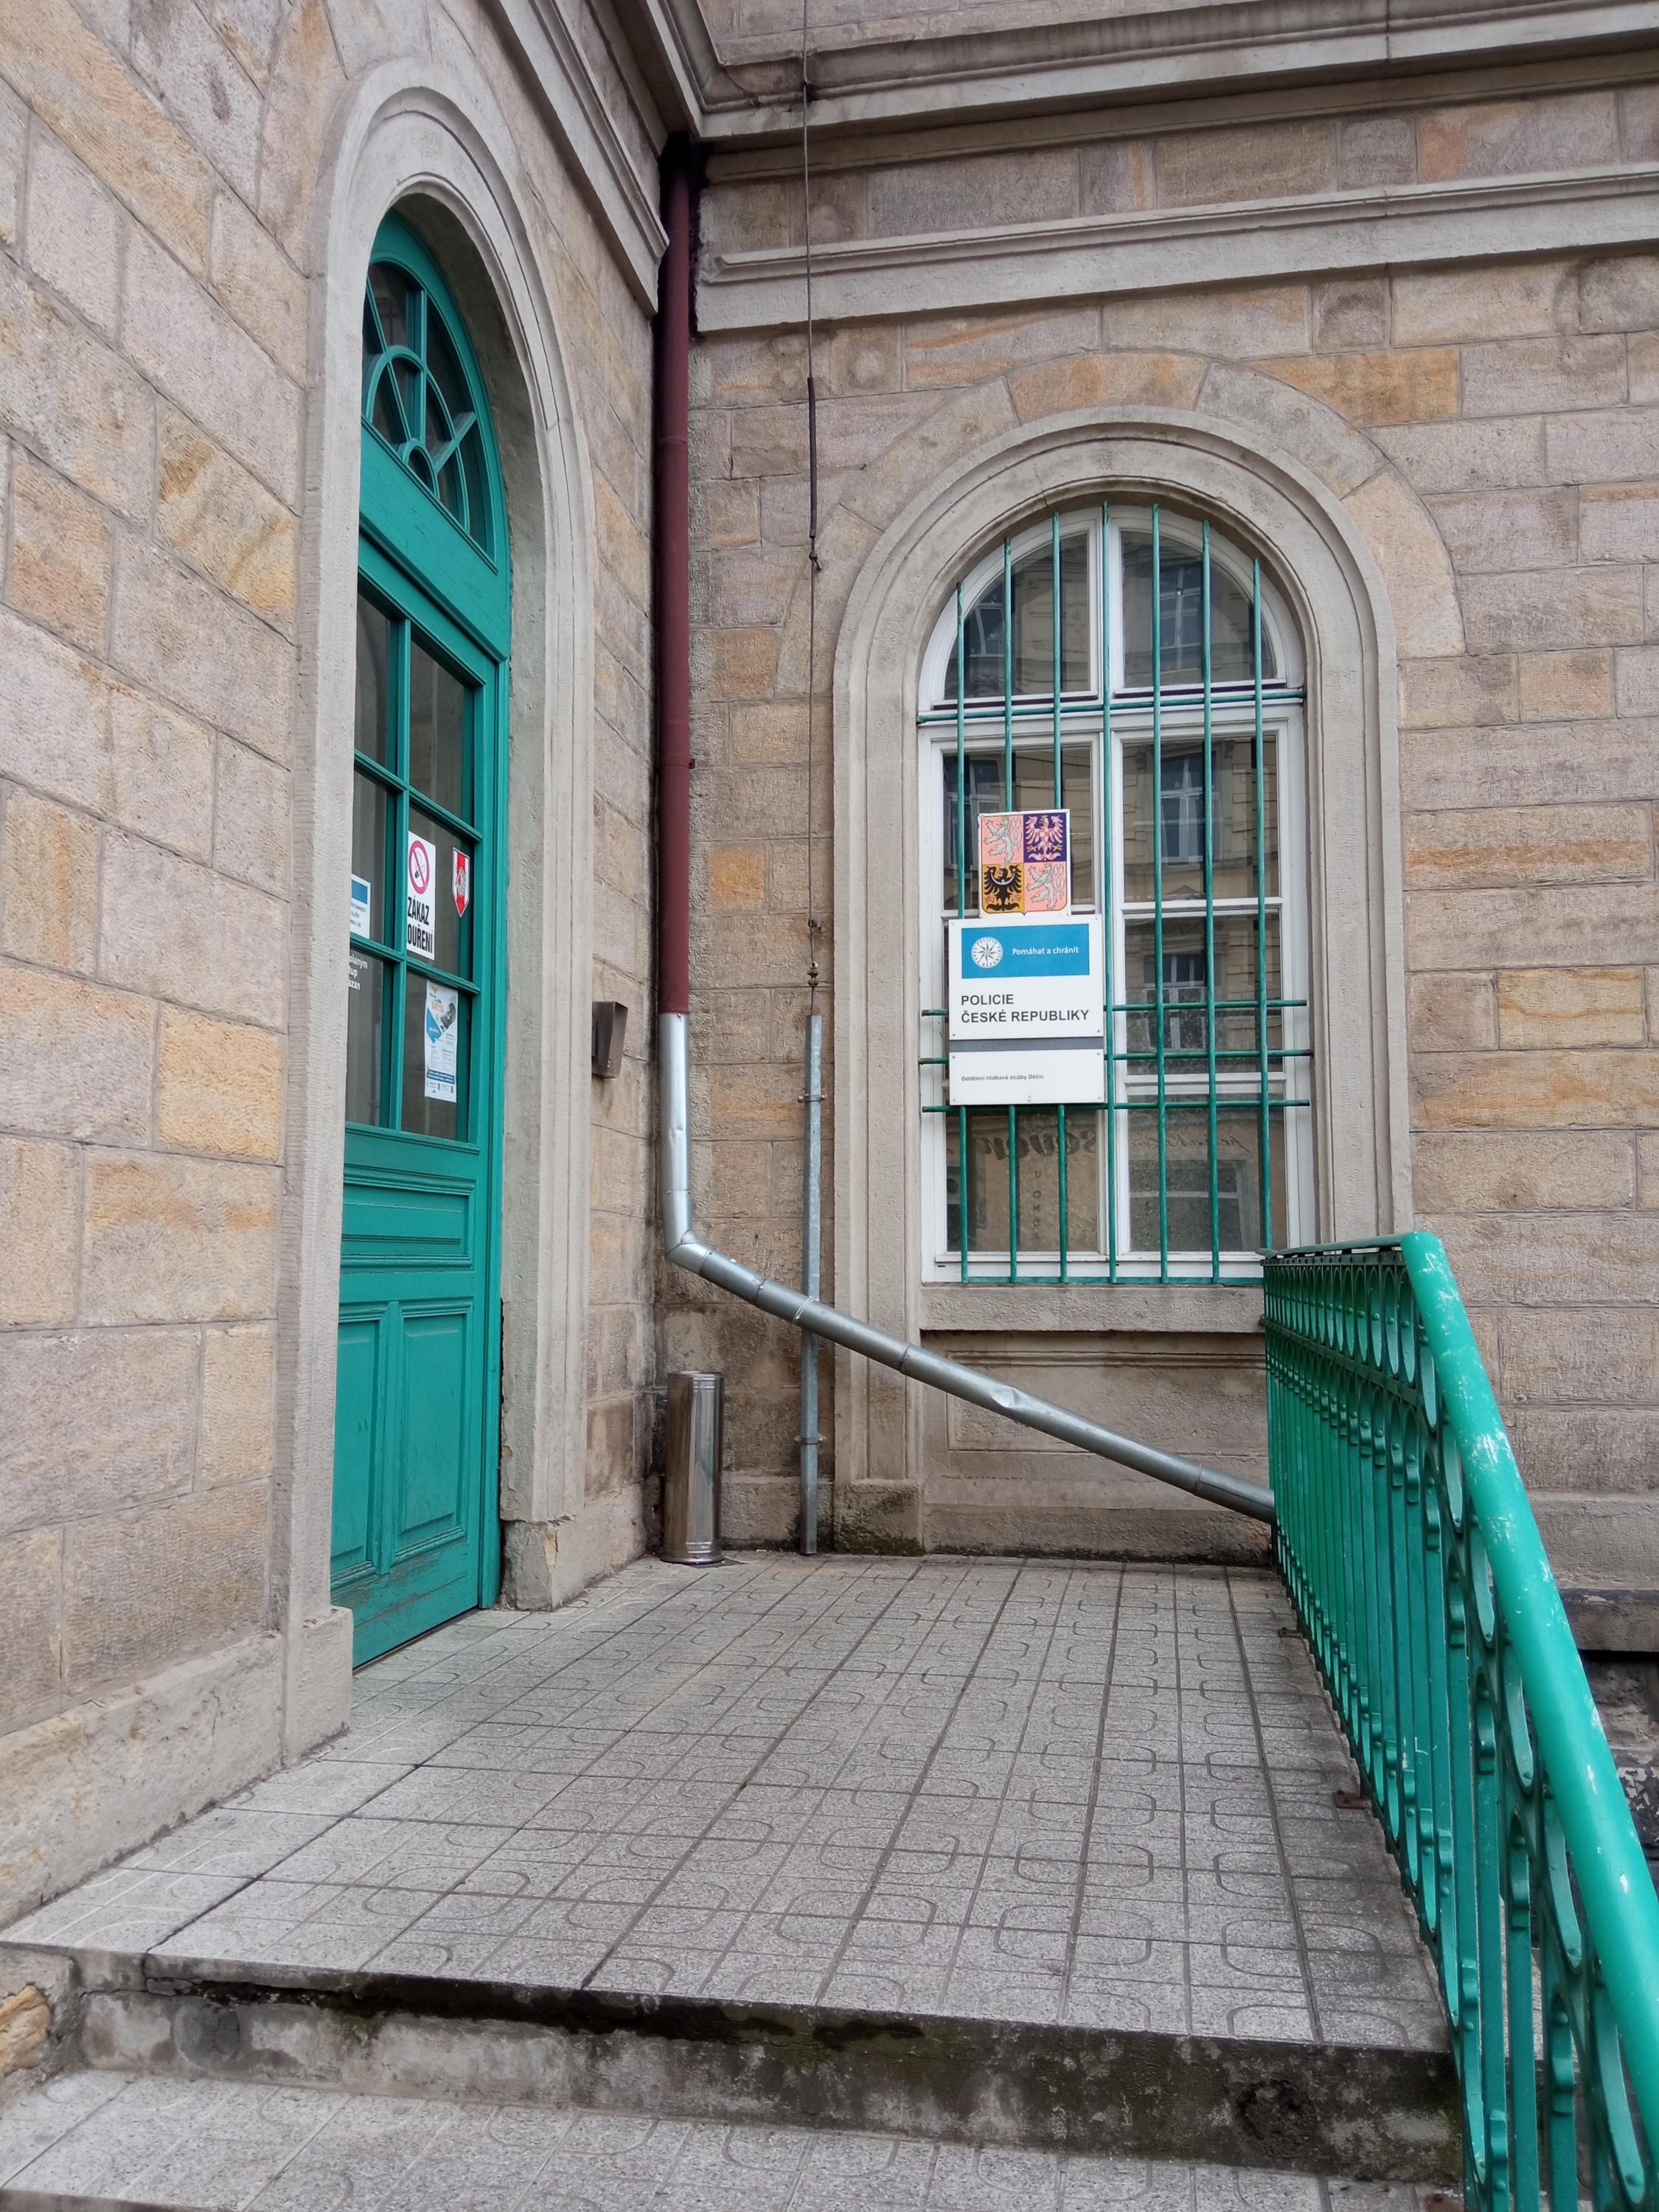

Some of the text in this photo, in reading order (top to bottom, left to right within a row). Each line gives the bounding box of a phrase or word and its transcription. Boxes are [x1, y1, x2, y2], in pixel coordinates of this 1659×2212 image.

[408, 896, 430, 925] ZÁKAZ
[407, 923, 434, 954] OUŘENÍ
[1012, 947, 1045, 956] Pomáhat
[1052, 946, 1079, 955] chránit
[348, 953, 368, 970] olaným
[961, 994, 1014, 1006] POLICIE
[961, 1009, 1090, 1023] ČESKÉ REPUBLIKY
